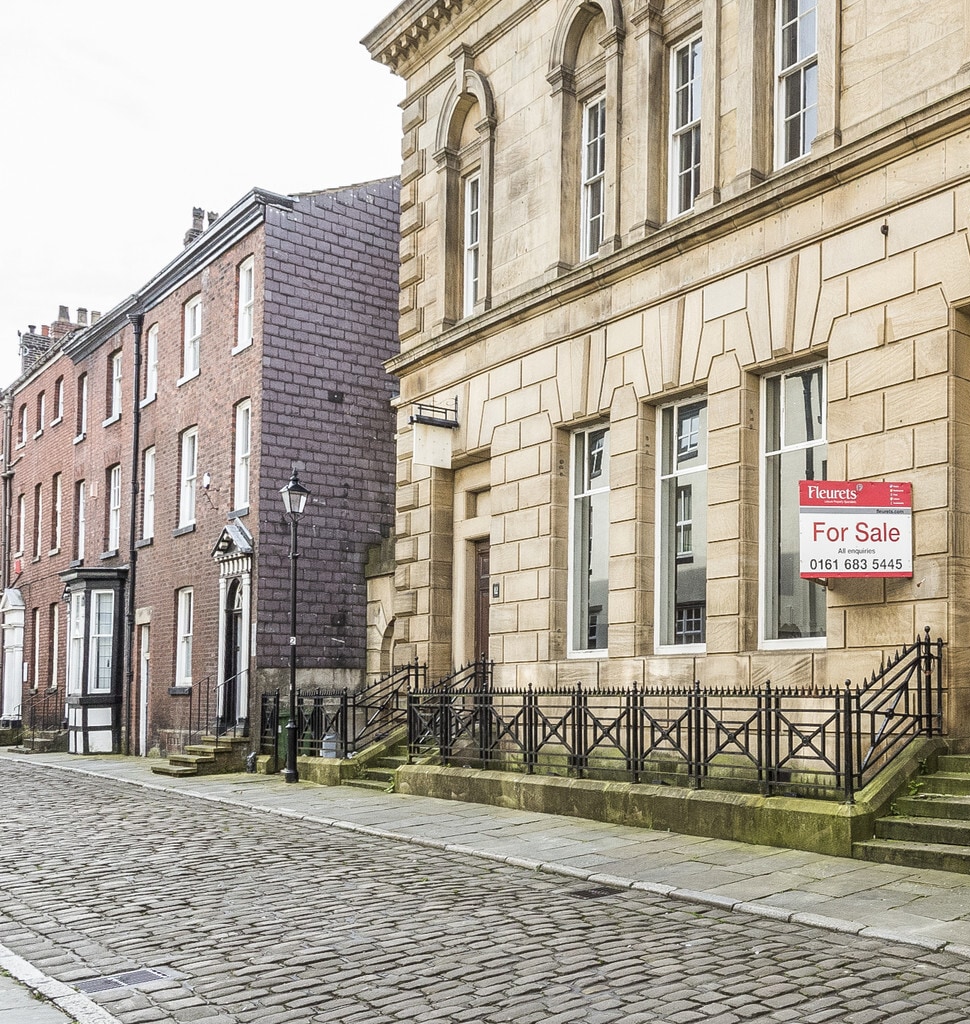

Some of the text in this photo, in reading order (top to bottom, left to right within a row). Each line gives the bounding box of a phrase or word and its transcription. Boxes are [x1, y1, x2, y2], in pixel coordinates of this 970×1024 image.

[807, 485, 858, 500] Fleurets
[813, 522, 901, 542] For Sale
[847, 547, 876, 555] enquiries
[810, 559, 903, 570] 0161 683 5445
